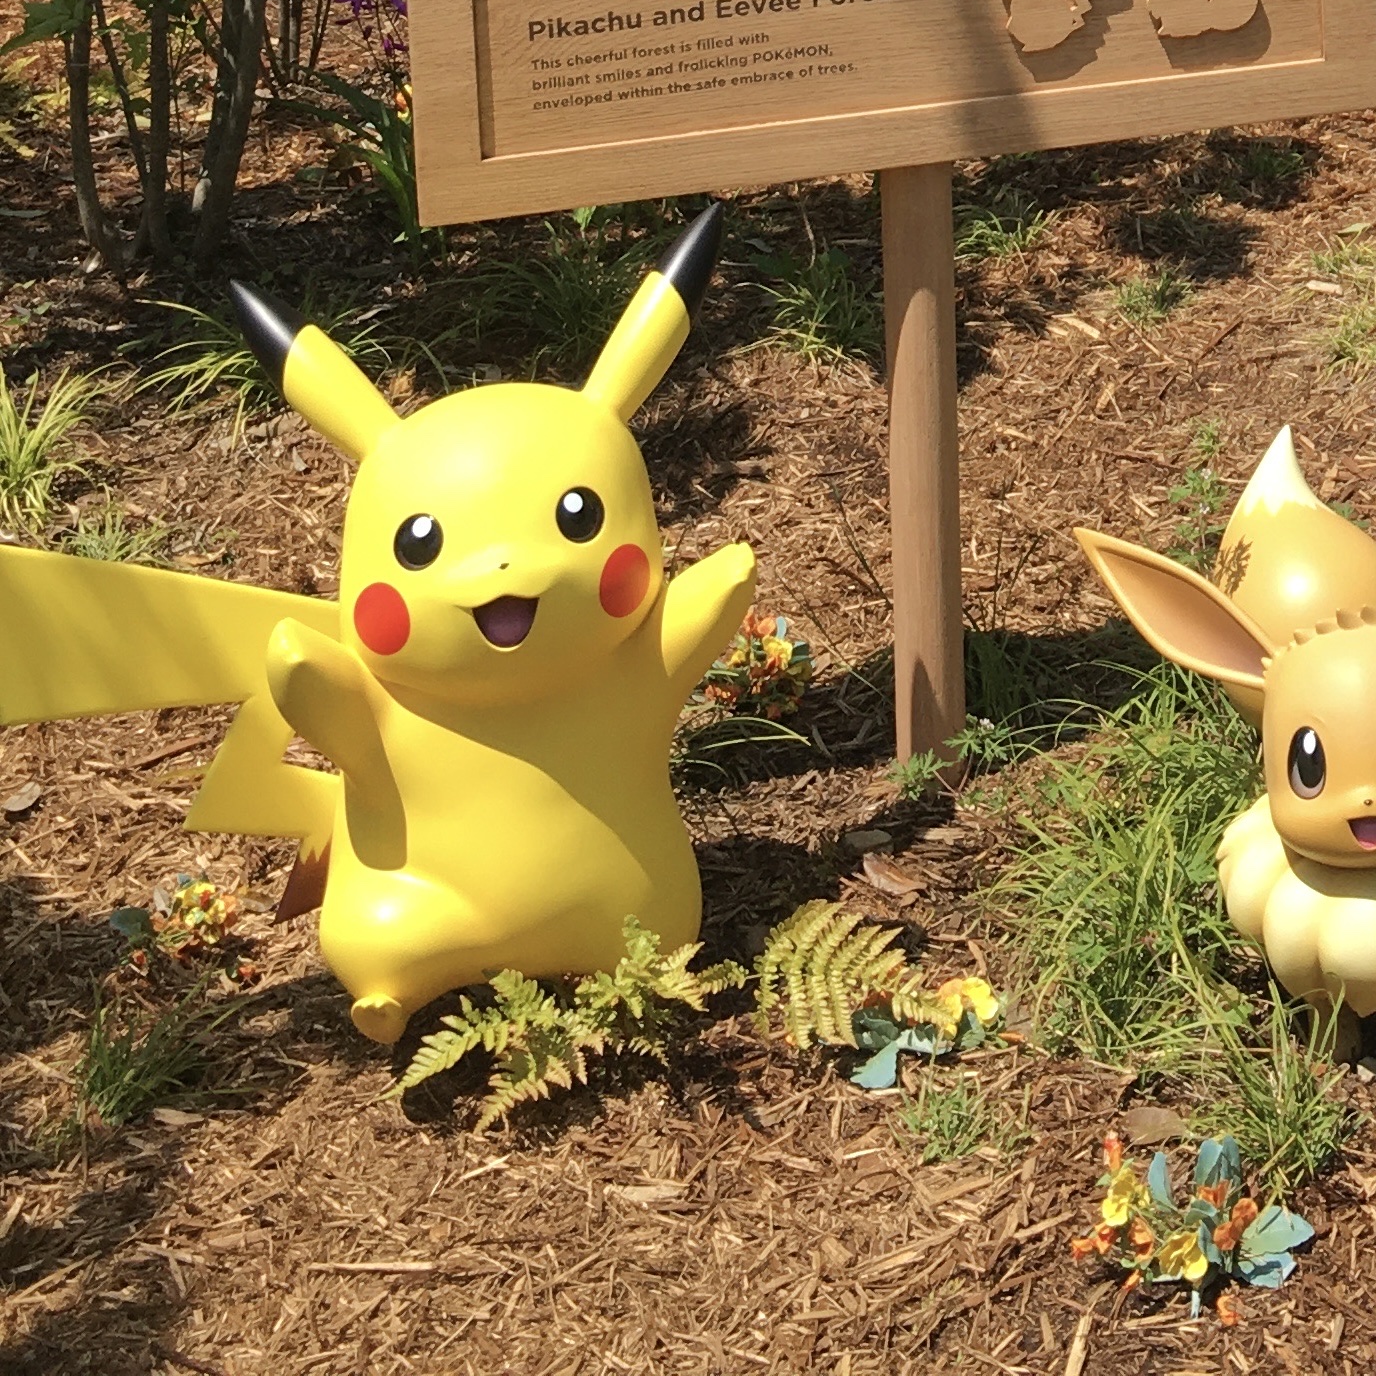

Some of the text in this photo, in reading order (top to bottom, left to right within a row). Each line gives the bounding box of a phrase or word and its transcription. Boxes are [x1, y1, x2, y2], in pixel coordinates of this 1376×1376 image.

[528, 11, 642, 41] Pikachu
[653, 0, 705, 26] and
[531, 32, 769, 71] This cheerful forest is filled with
[532, 74, 590, 91] brilliant
[595, 68, 641, 83] smiles
[646, 62, 673, 77] and
[678, 55, 748, 73] frolicking
[533, 61, 858, 110] enveloped within the safe embrace of trees.
